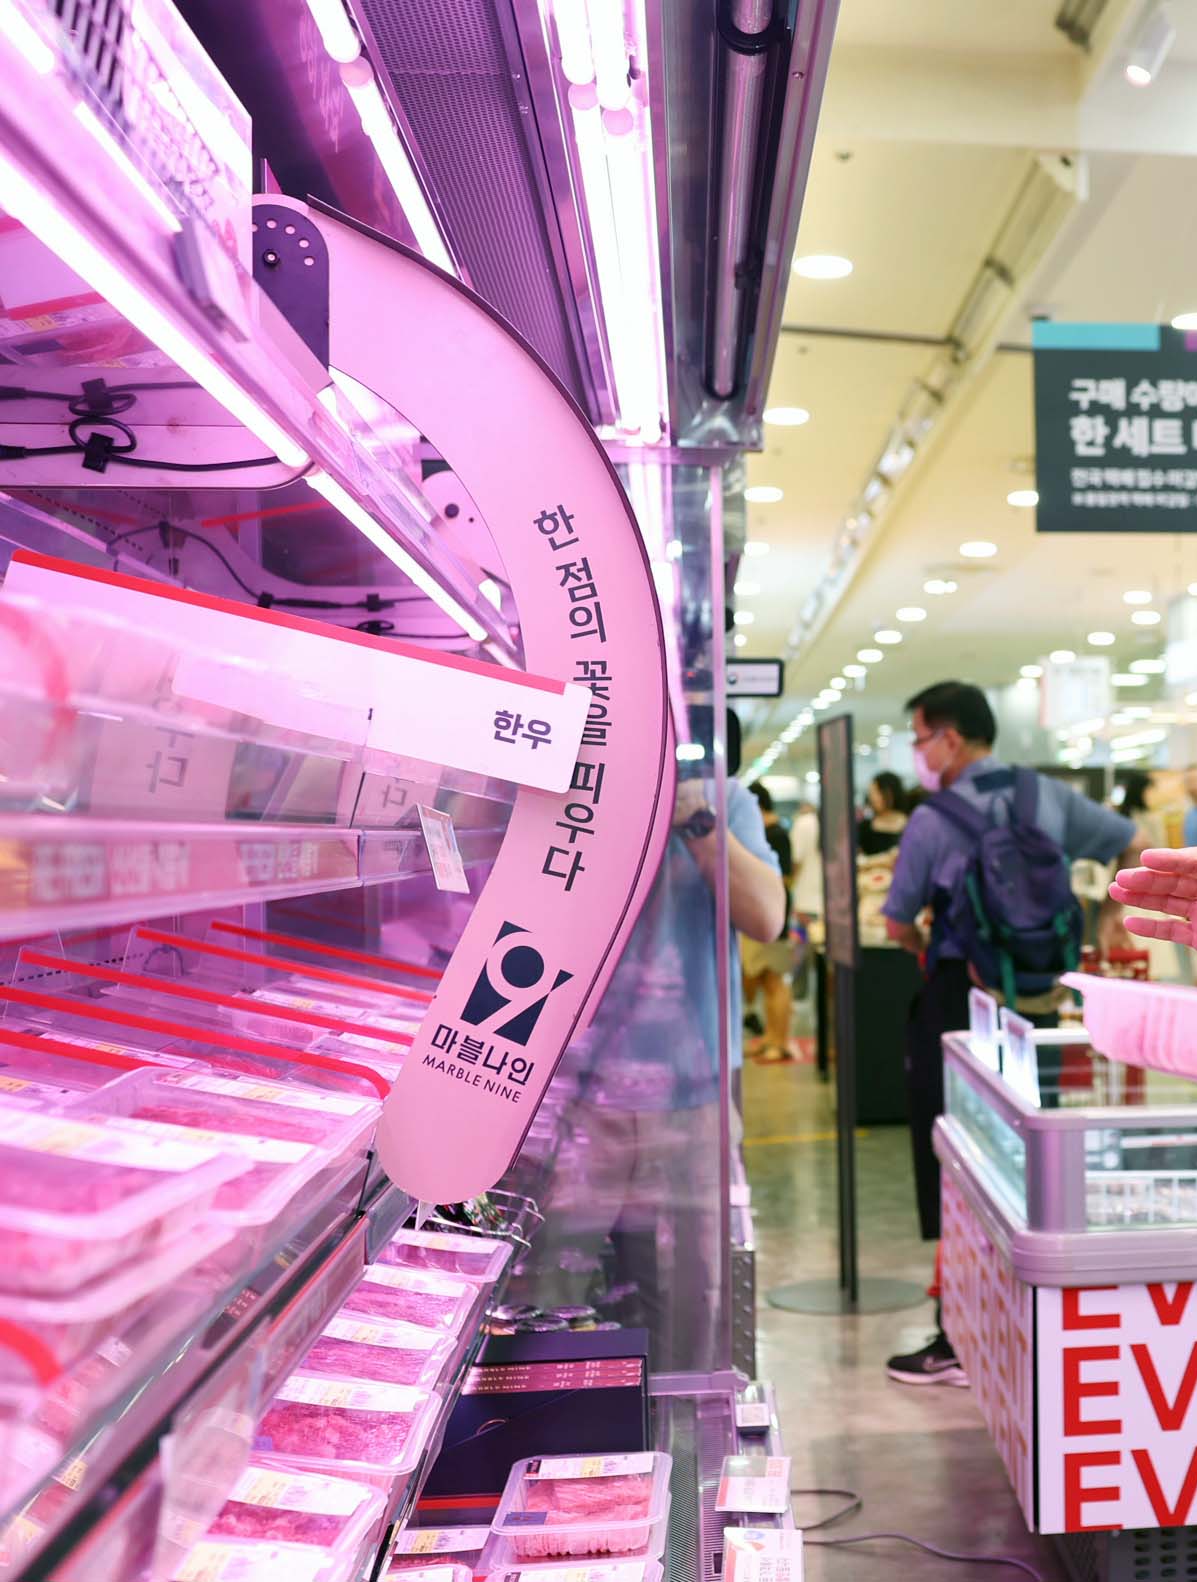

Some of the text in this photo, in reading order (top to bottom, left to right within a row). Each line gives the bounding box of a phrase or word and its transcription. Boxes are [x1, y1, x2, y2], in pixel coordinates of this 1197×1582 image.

[1069, 378, 1126, 411] 구매
[1069, 414, 1110, 457] 한
[1112, 416, 1187, 458] 세트
[533, 504, 580, 551] 한
[555, 556, 607, 643] 점의
[493, 710, 552, 750] 한우
[541, 761, 606, 892] 피우다
[422, 1054, 522, 1104] MARBLE NINE
[431, 1024, 534, 1086] 마블나인
